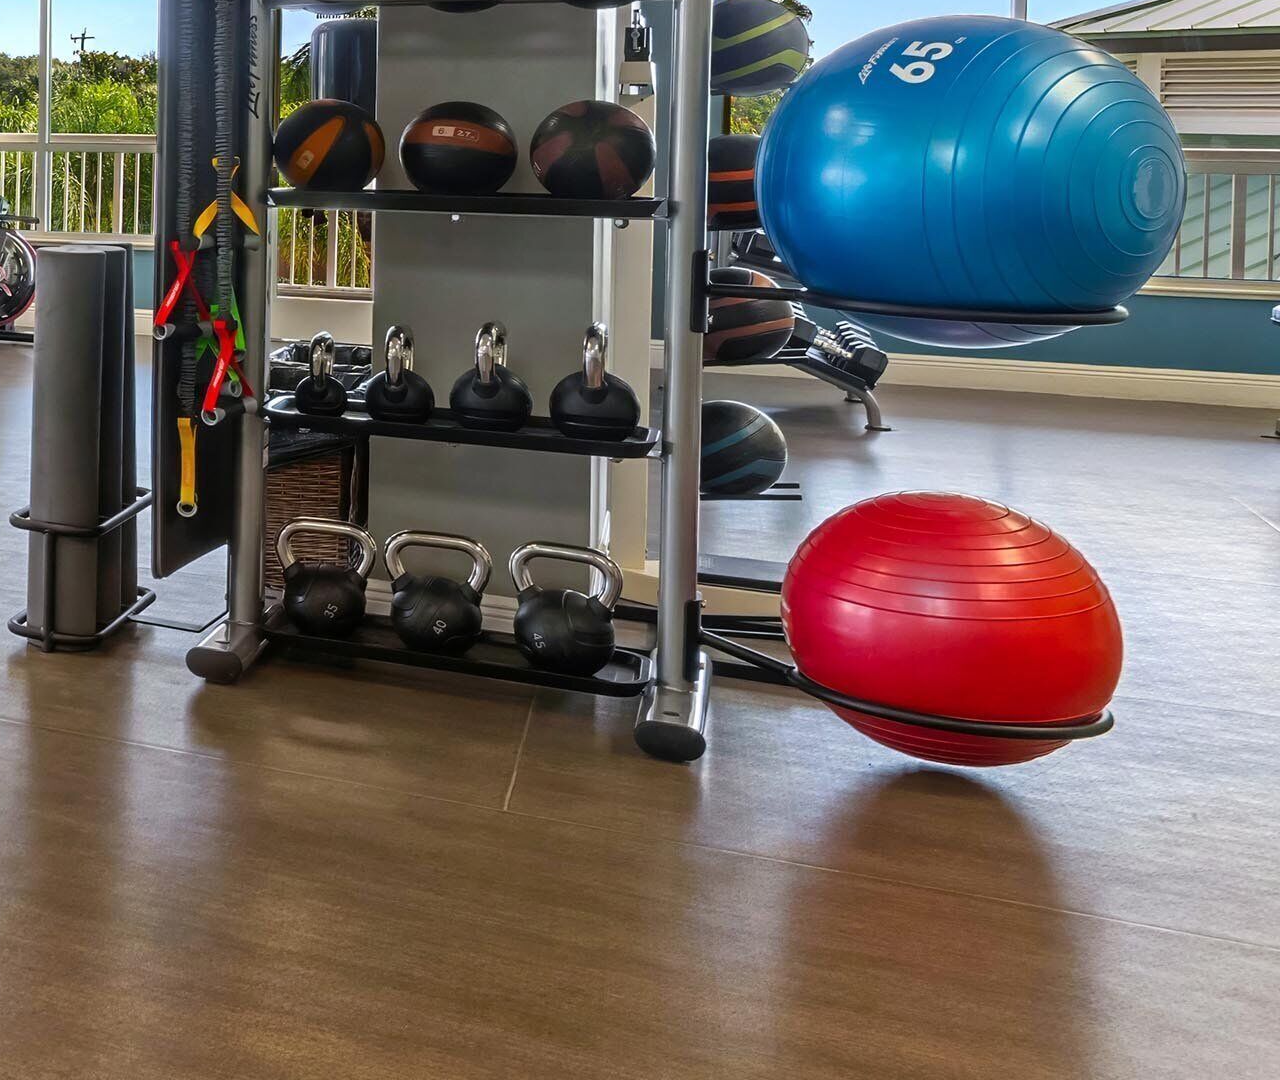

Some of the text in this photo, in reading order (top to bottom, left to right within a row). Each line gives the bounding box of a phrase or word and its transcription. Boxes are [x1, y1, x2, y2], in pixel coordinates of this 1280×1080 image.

[889, 41, 953, 84] 65
[323, 603, 338, 619] 35
[433, 620, 447, 635] 40
[533, 633, 546, 648] 45
